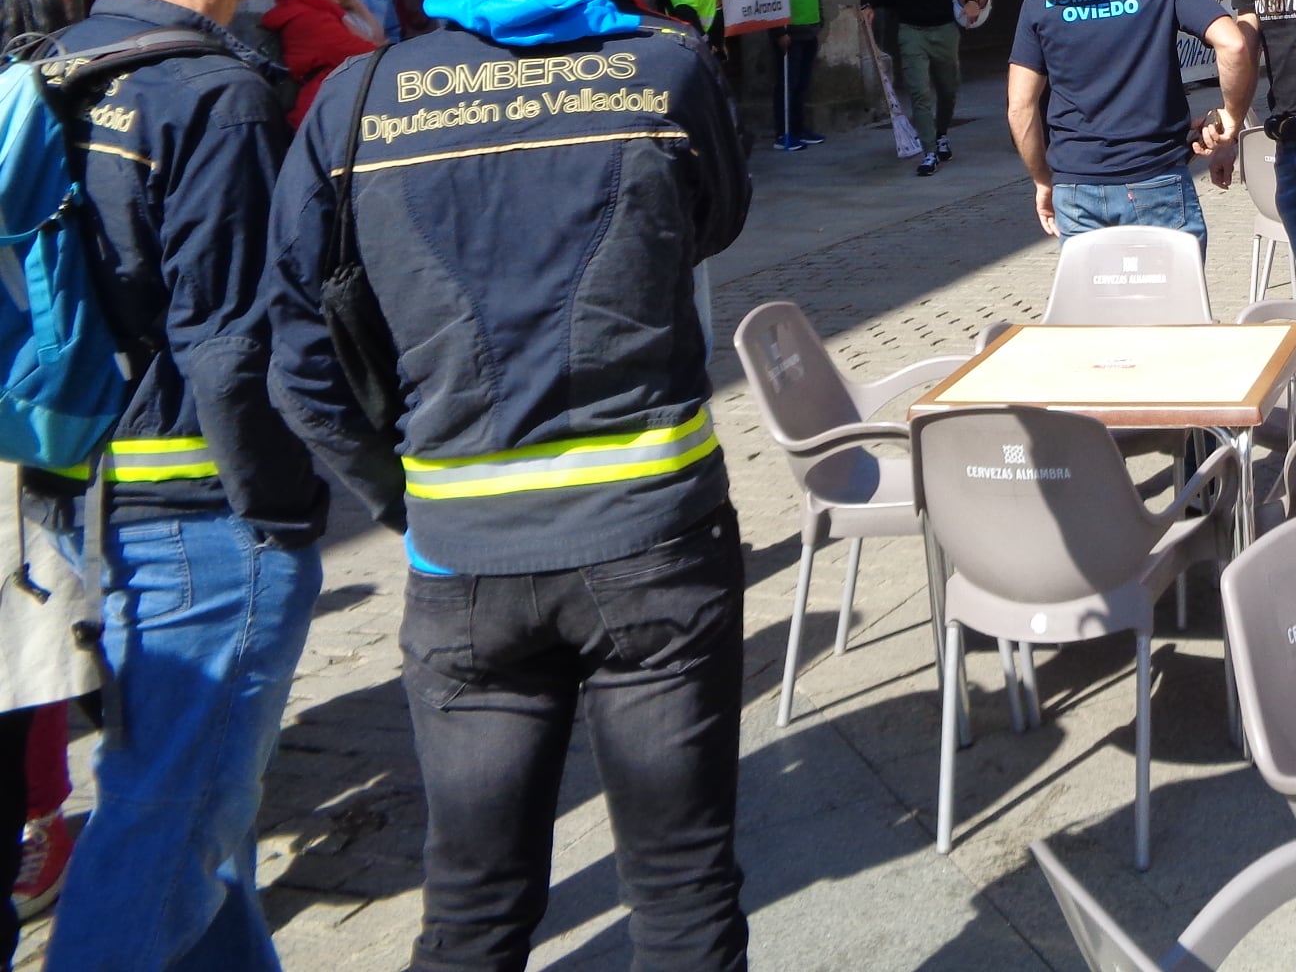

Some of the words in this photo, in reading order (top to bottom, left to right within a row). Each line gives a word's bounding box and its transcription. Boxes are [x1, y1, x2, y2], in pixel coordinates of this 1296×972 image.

[742, 5, 754, 17] en
[397, 53, 636, 102] BOMBEROS
[361, 100, 499, 144] Diputación
[505, 96, 542, 120] de
[542, 88, 669, 115] Valladolid
[966, 466, 1013, 480] CERVEZAS
[1016, 467, 1071, 480] ALHAMBRA
